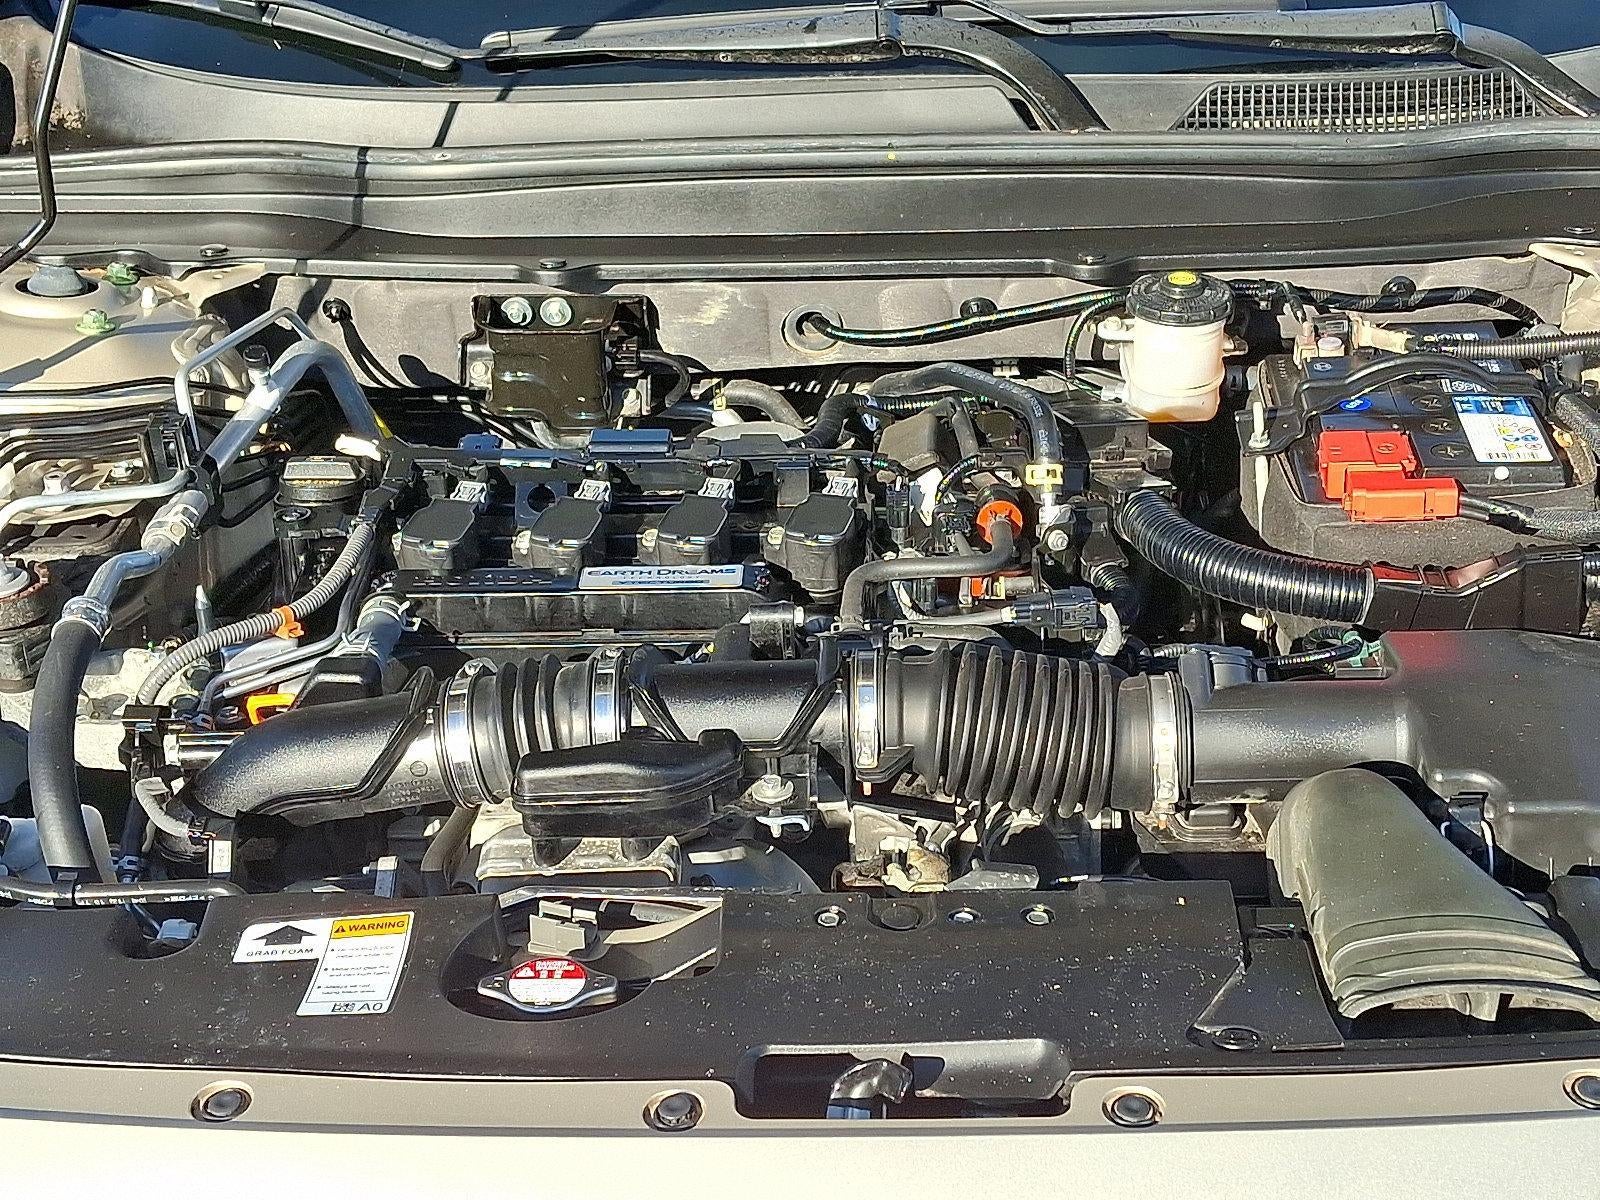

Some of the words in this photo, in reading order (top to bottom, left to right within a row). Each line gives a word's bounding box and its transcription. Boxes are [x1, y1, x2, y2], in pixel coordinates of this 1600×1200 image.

[588, 569, 653, 577] EARTH
[656, 568, 737, 576] DREAMS
[348, 920, 405, 932] WARNING
